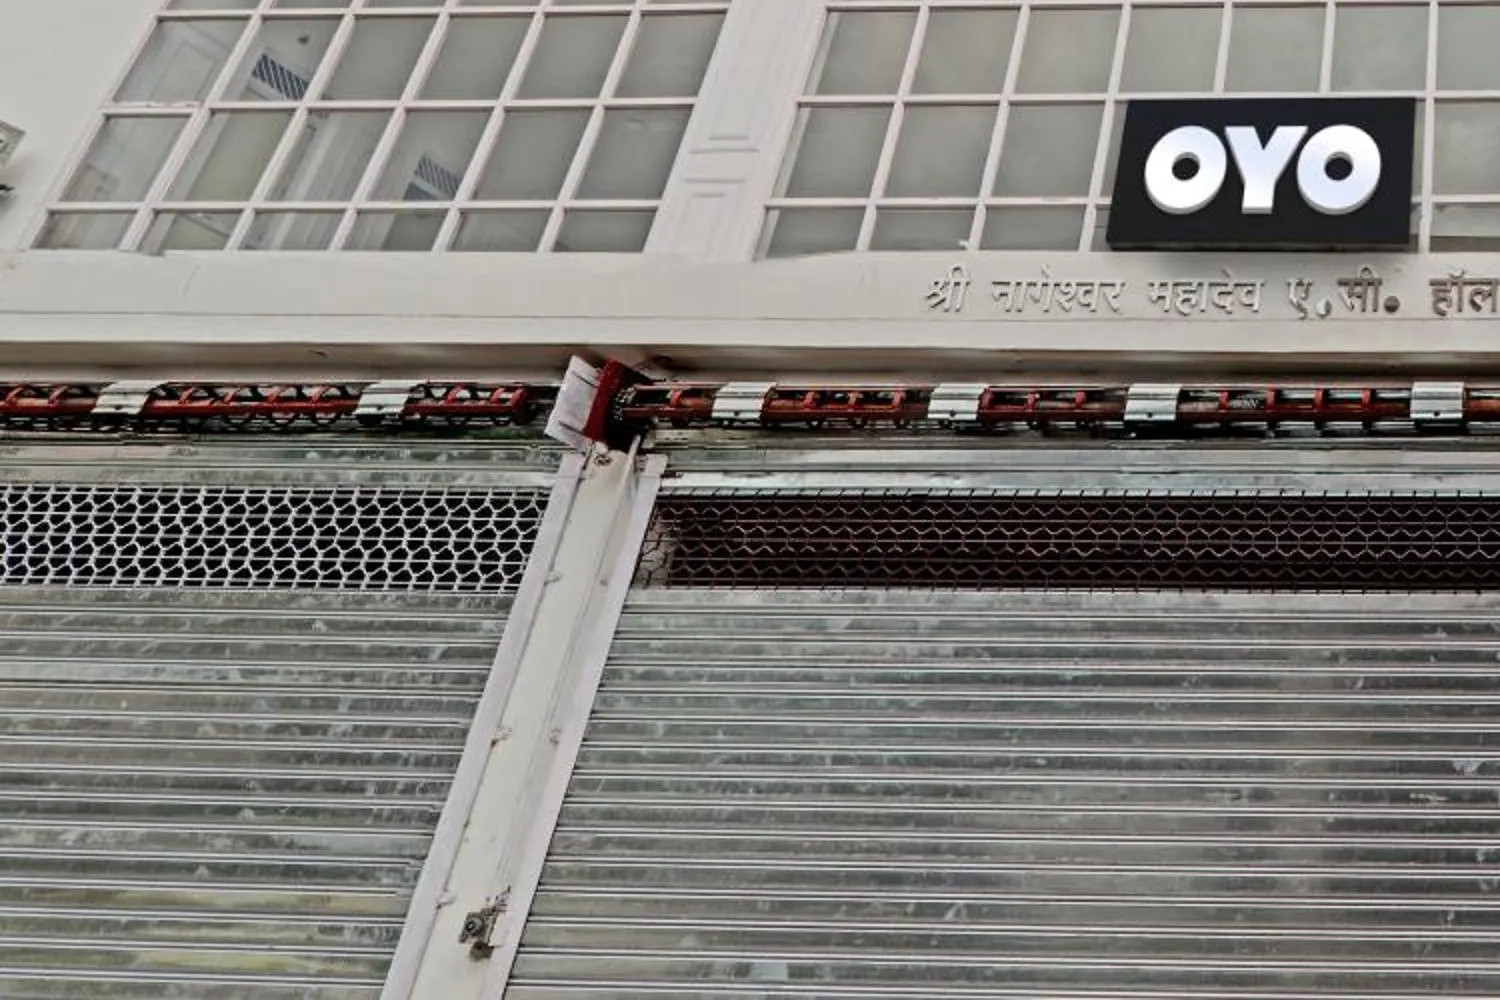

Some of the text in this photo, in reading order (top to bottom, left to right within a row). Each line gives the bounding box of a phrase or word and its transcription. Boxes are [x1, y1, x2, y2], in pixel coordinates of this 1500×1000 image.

[1145, 124, 1381, 215] OYO
[925, 263, 971, 313] श्री
[991, 263, 1127, 314] नागेश्वर
[1148, 267, 1265, 316] महादेव
[1429, 269, 1500, 316] हॉल
